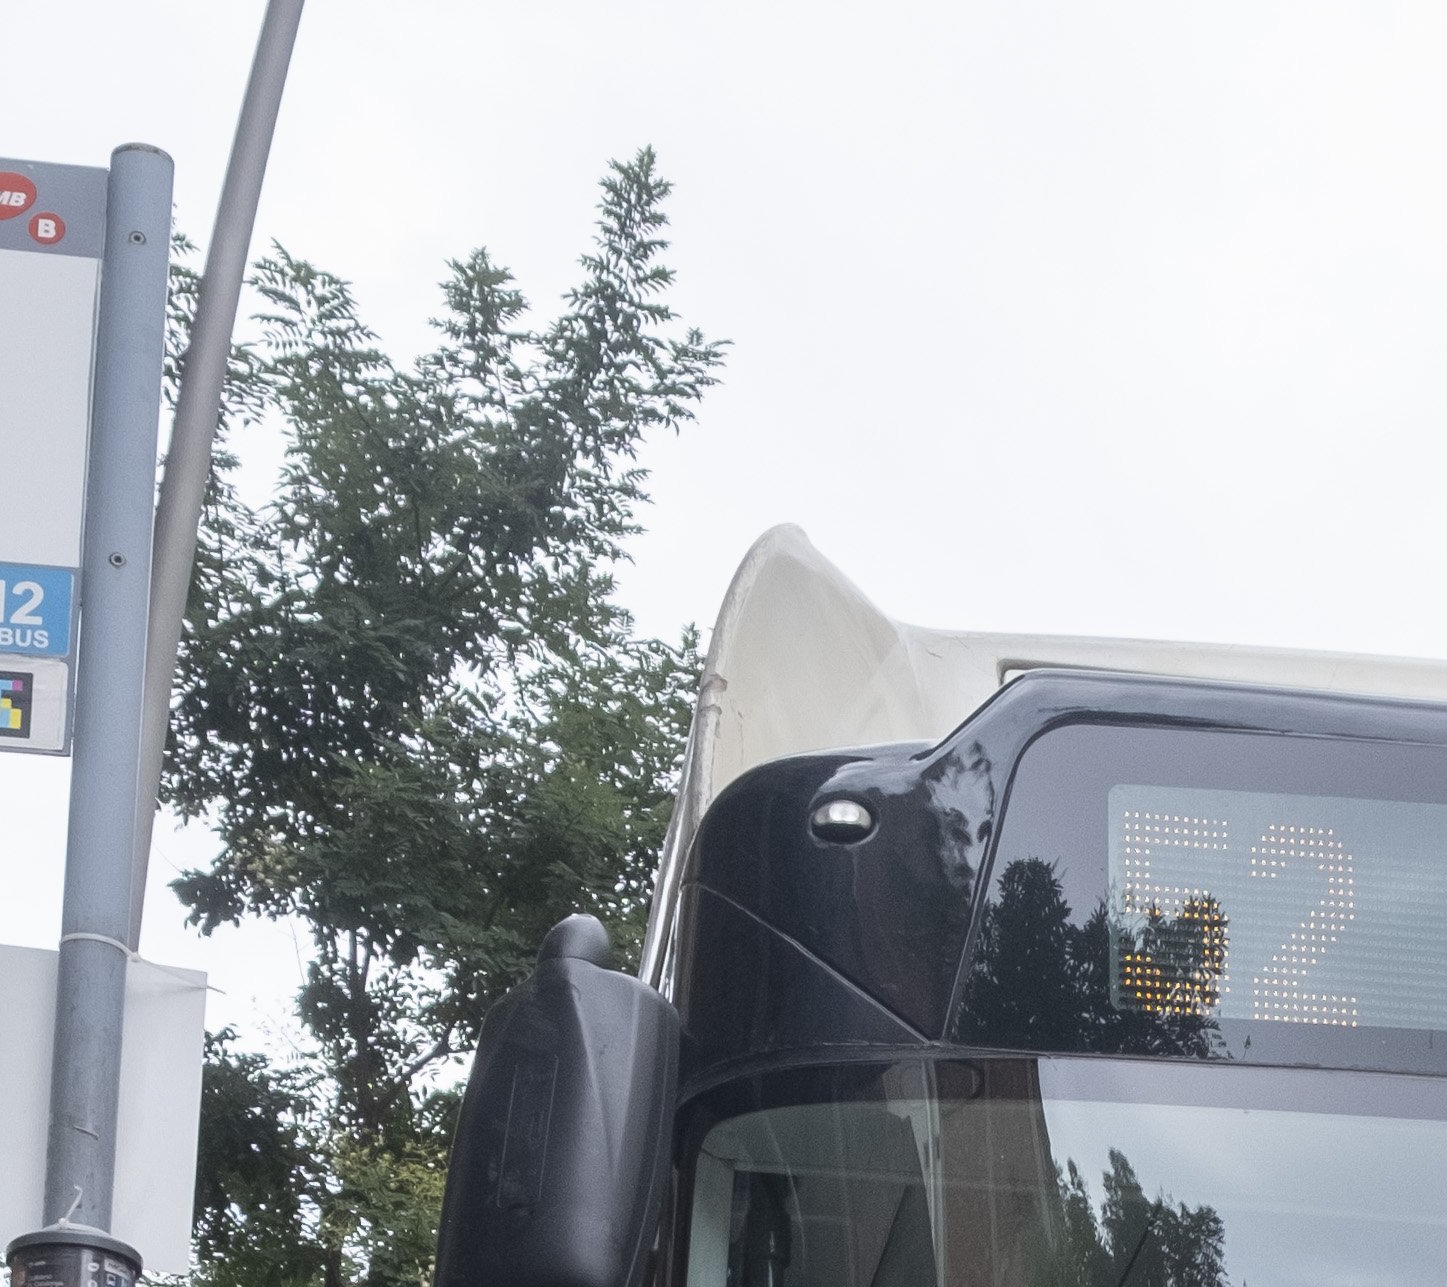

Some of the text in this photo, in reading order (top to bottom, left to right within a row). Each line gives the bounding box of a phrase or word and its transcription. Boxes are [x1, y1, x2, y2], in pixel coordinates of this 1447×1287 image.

[36, 219, 57, 238] B
[2, 627, 49, 650] BUS
[1122, 808, 1358, 1027] 52
